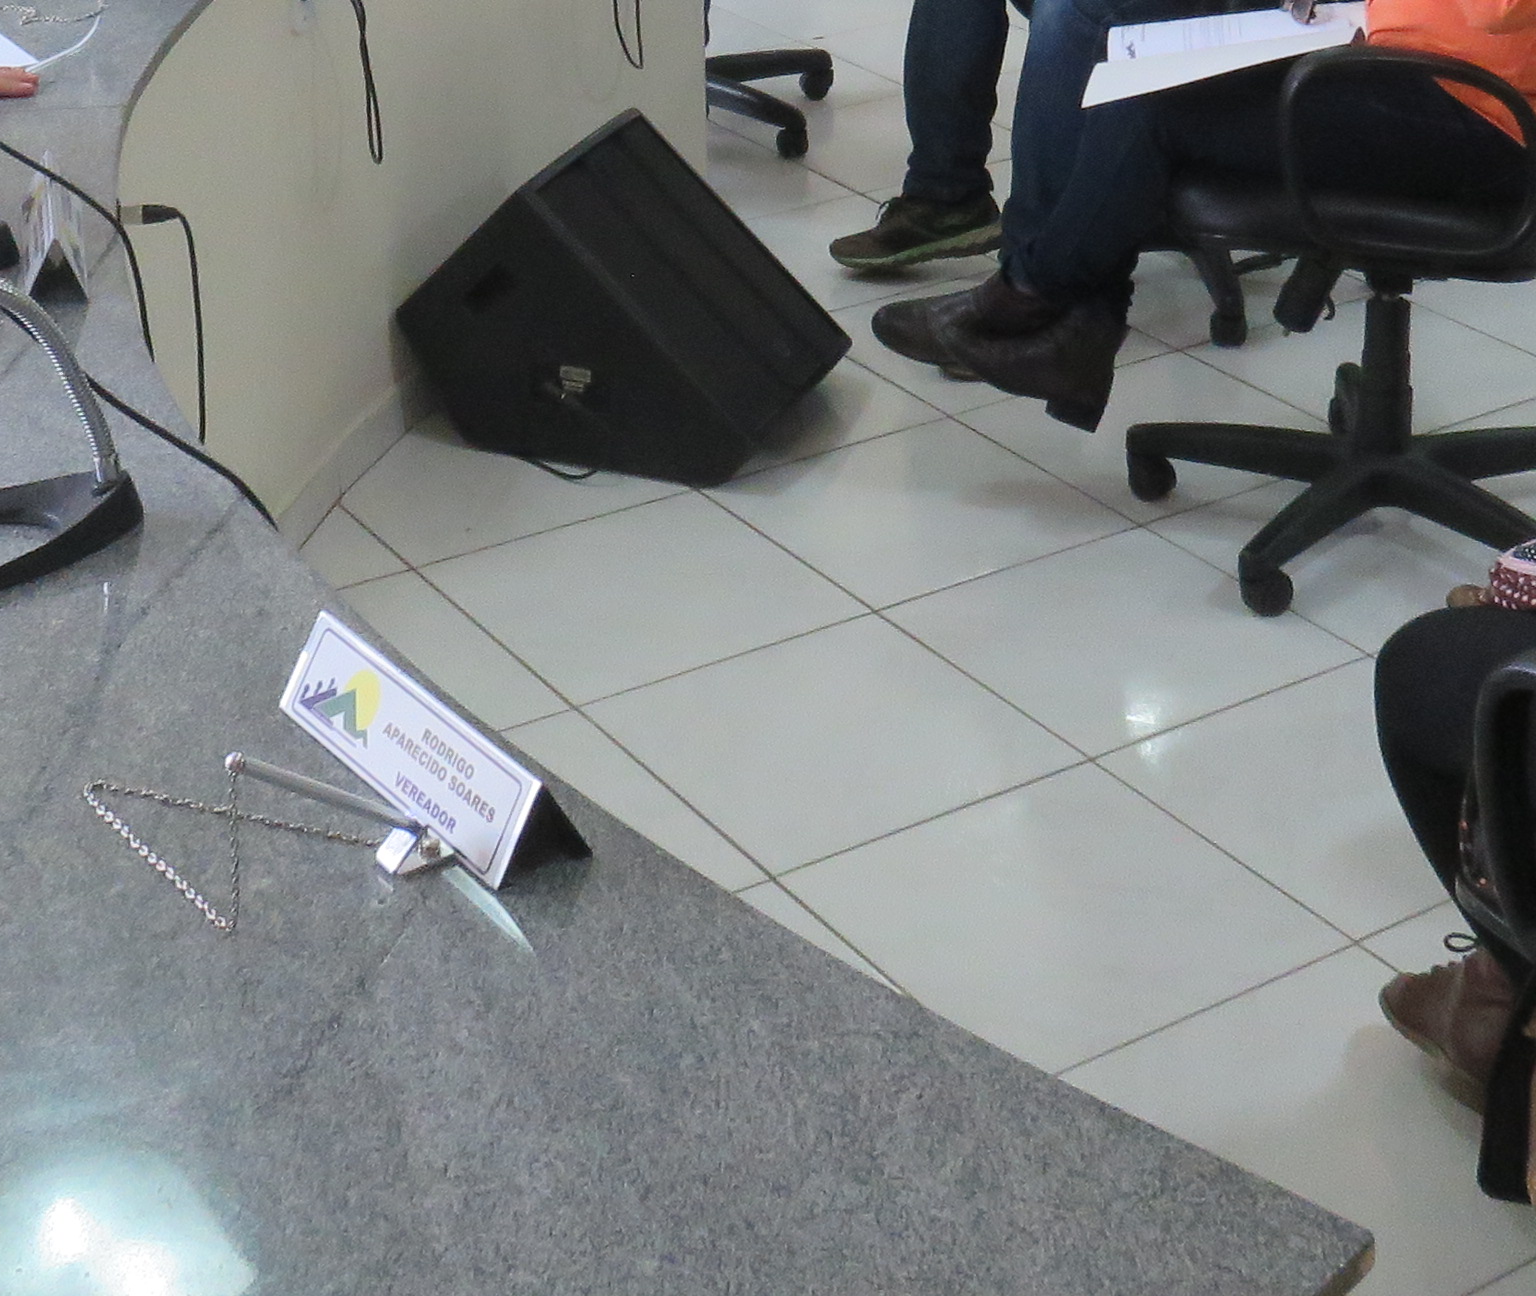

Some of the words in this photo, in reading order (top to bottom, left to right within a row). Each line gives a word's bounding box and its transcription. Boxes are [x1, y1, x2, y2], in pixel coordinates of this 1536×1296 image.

[382, 722, 448, 782] APARECIDO
[447, 775, 496, 823] SOARES
[421, 728, 475, 780] RODRIGO
[394, 770, 458, 834] VEREADOR
